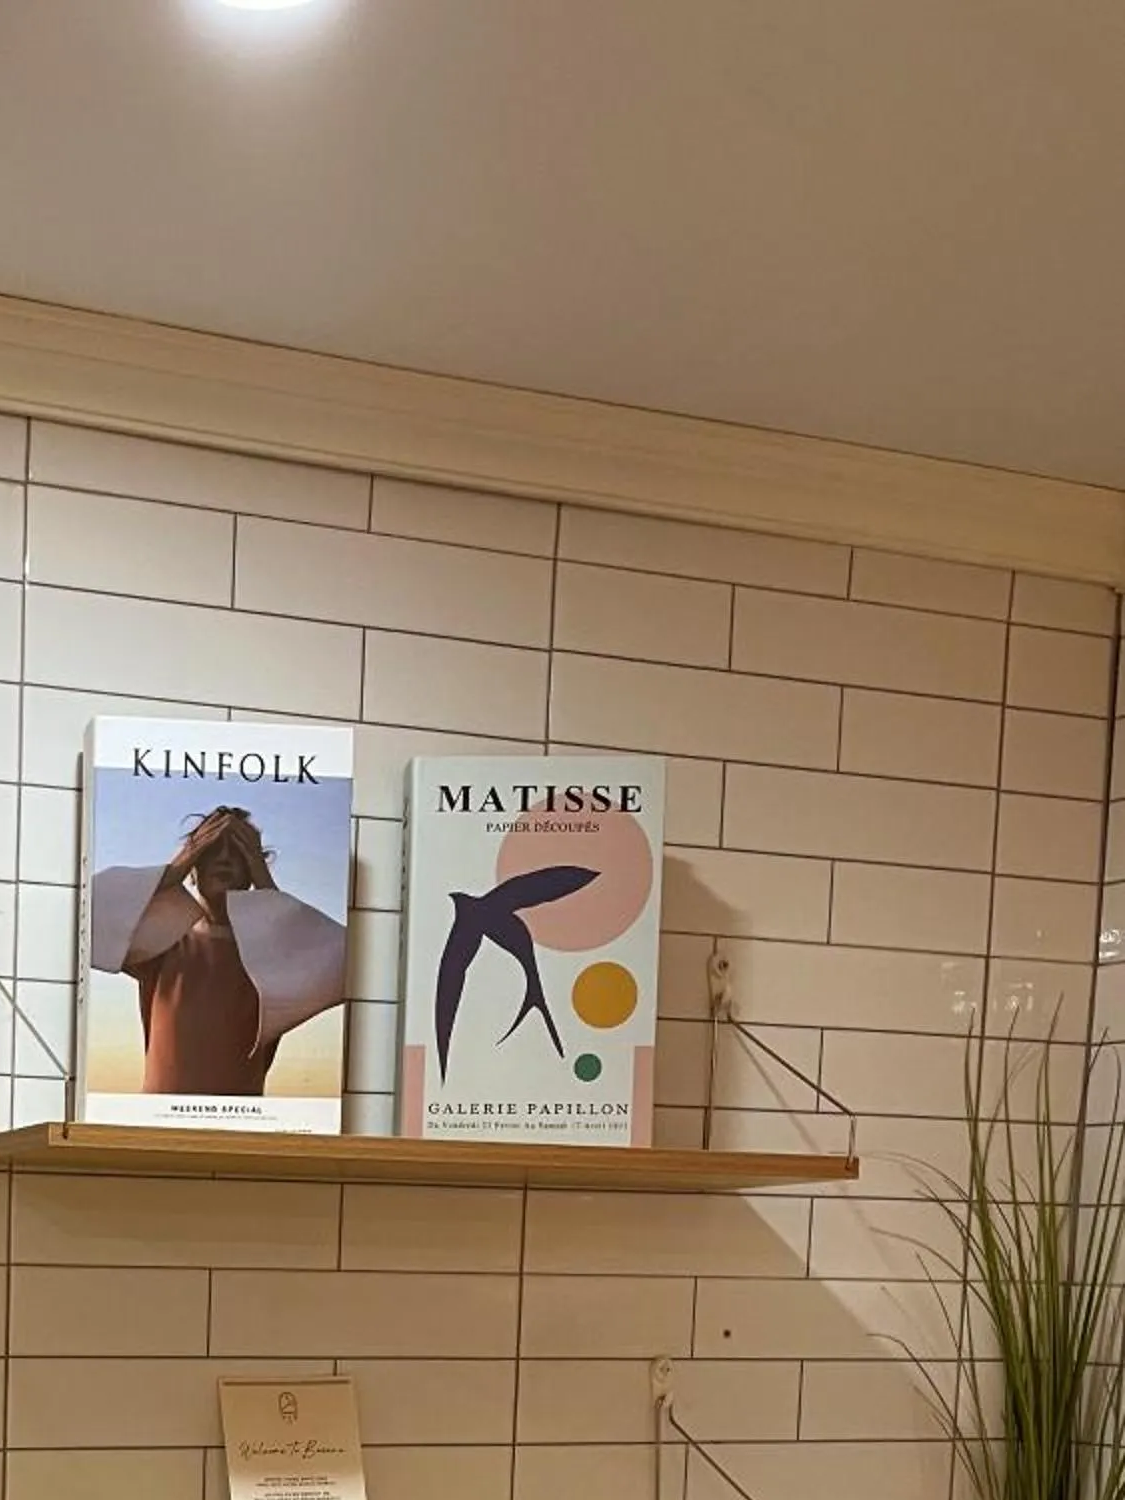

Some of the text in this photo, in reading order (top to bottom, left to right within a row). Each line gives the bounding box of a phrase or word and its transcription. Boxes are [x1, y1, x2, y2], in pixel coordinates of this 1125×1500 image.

[132, 747, 320, 785] KINFOLK
[436, 784, 643, 813] MATISSE
[485, 820, 601, 833] PAPIER DÉCOUPÉS
[427, 1102, 629, 1115] GALERIE PAPILLON
